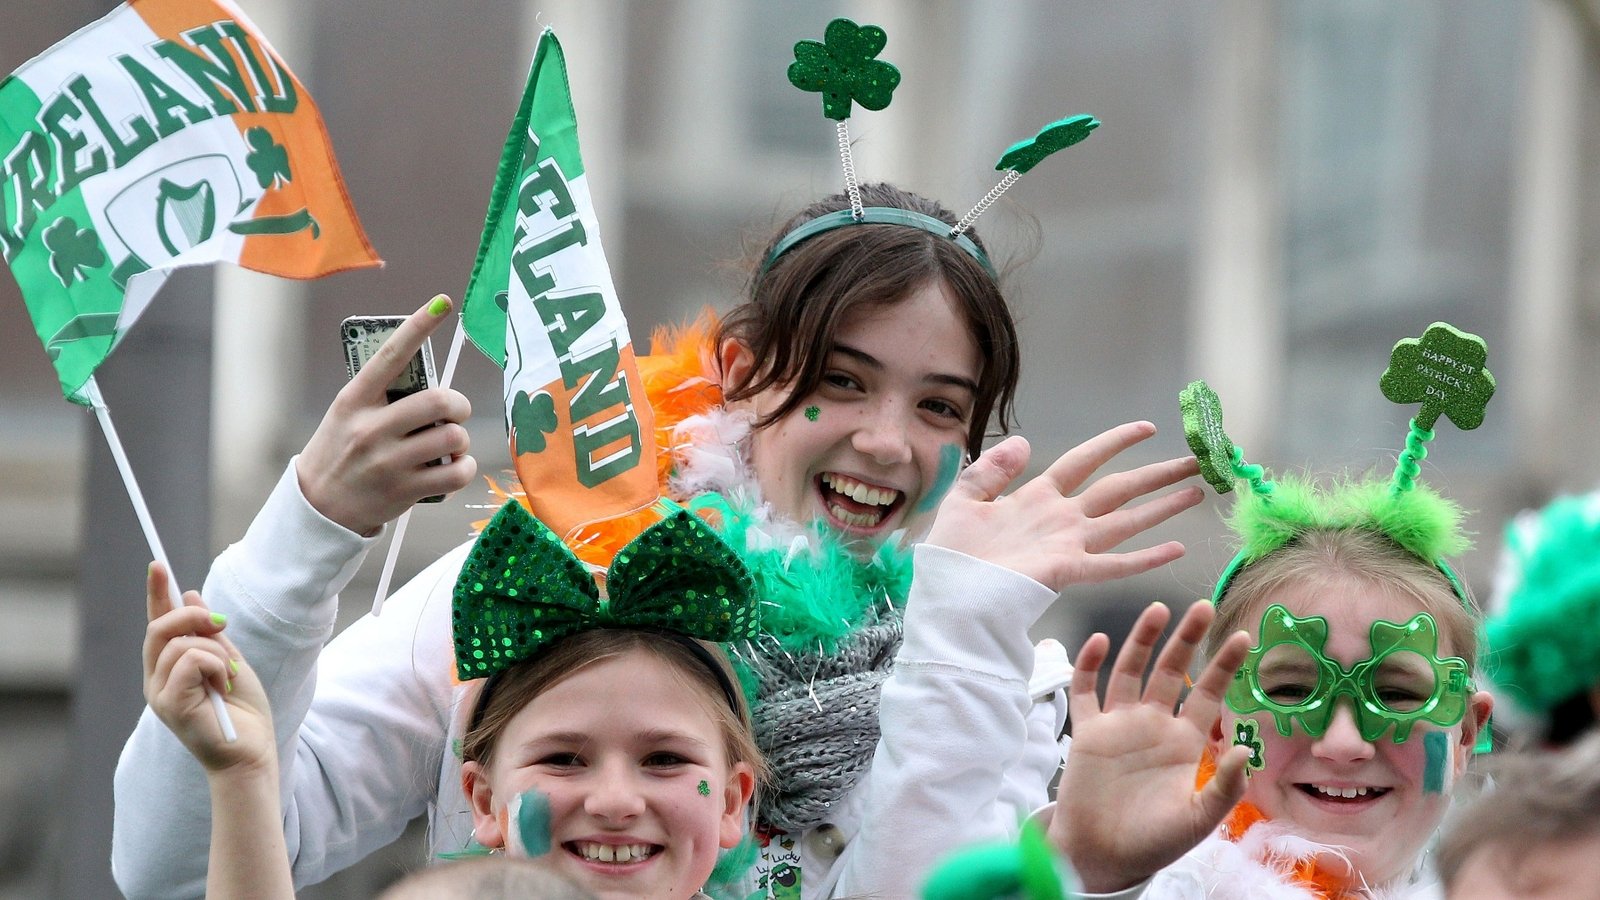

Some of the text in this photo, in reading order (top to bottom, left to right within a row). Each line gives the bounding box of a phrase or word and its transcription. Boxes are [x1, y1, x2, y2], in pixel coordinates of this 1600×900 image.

[511, 126, 642, 490] ELAND
[1422, 348, 1475, 375] HAPPY ST
[1425, 385, 1447, 400] DAY
[771, 851, 801, 864] Lucky
